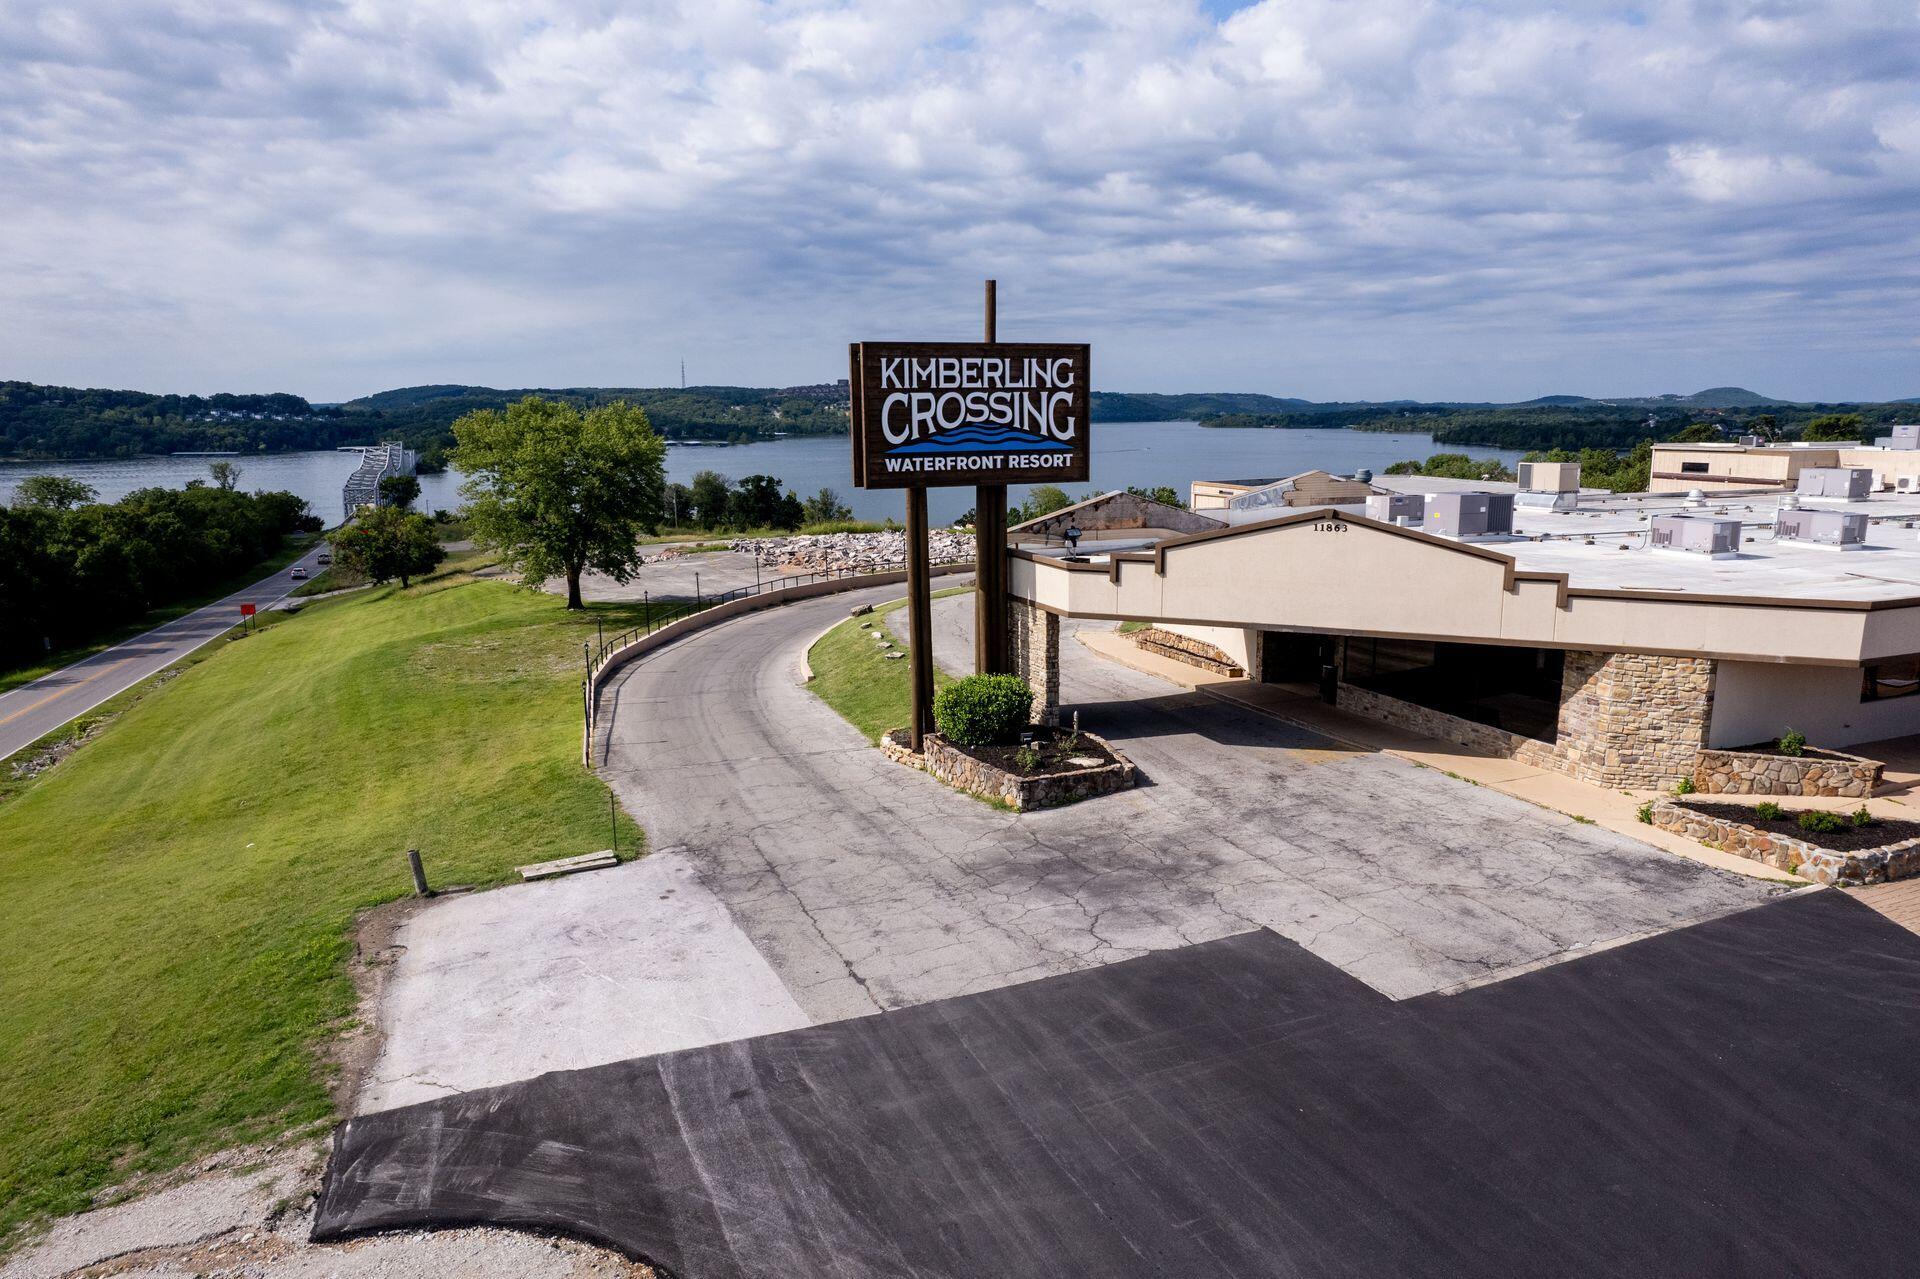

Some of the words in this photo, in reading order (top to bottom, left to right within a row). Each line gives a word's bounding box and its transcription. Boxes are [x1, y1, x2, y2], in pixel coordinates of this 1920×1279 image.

[880, 357, 1075, 389] KIMBERLING
[881, 391, 1076, 445] CROSSING
[885, 455, 1004, 472] WATERFRONT
[1008, 453, 1073, 469] RESORT
[1313, 523, 1348, 532] 11863
